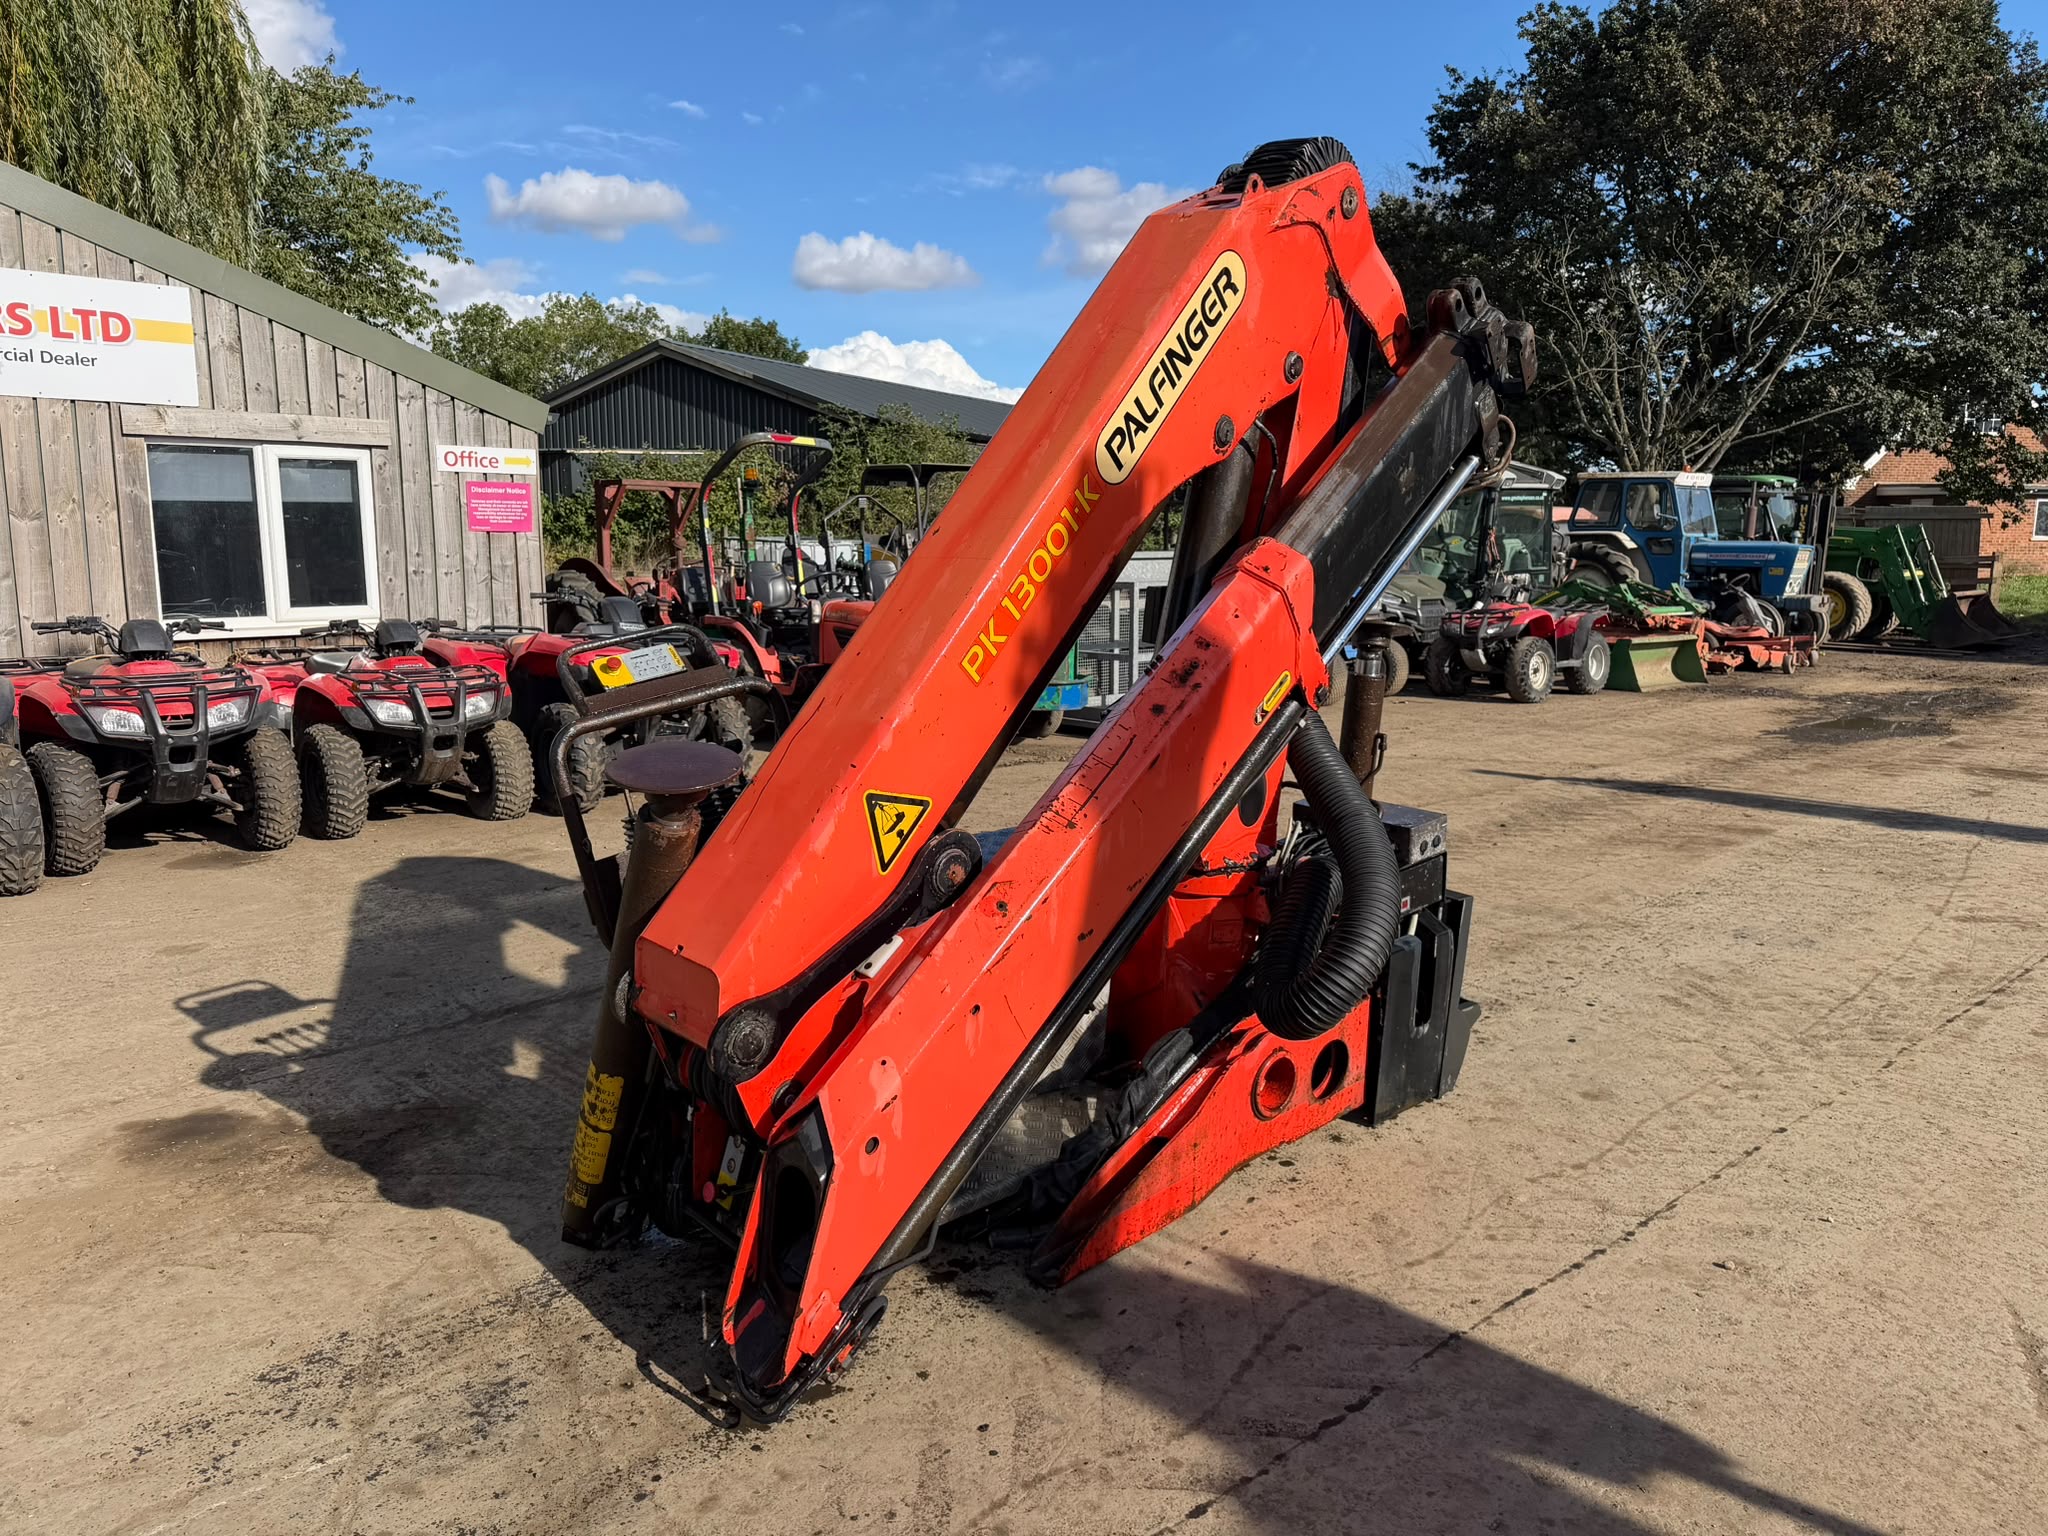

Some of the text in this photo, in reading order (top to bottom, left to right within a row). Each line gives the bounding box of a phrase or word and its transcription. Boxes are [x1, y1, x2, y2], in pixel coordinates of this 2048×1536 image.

[0, 302, 132, 343] S LTD
[40, 350, 98, 367] Dealer
[1104, 266, 1241, 472] PALFINGER
[444, 451, 499, 468] Office
[471, 486, 505, 494] Disclaimer
[960, 624, 1008, 683] PK
